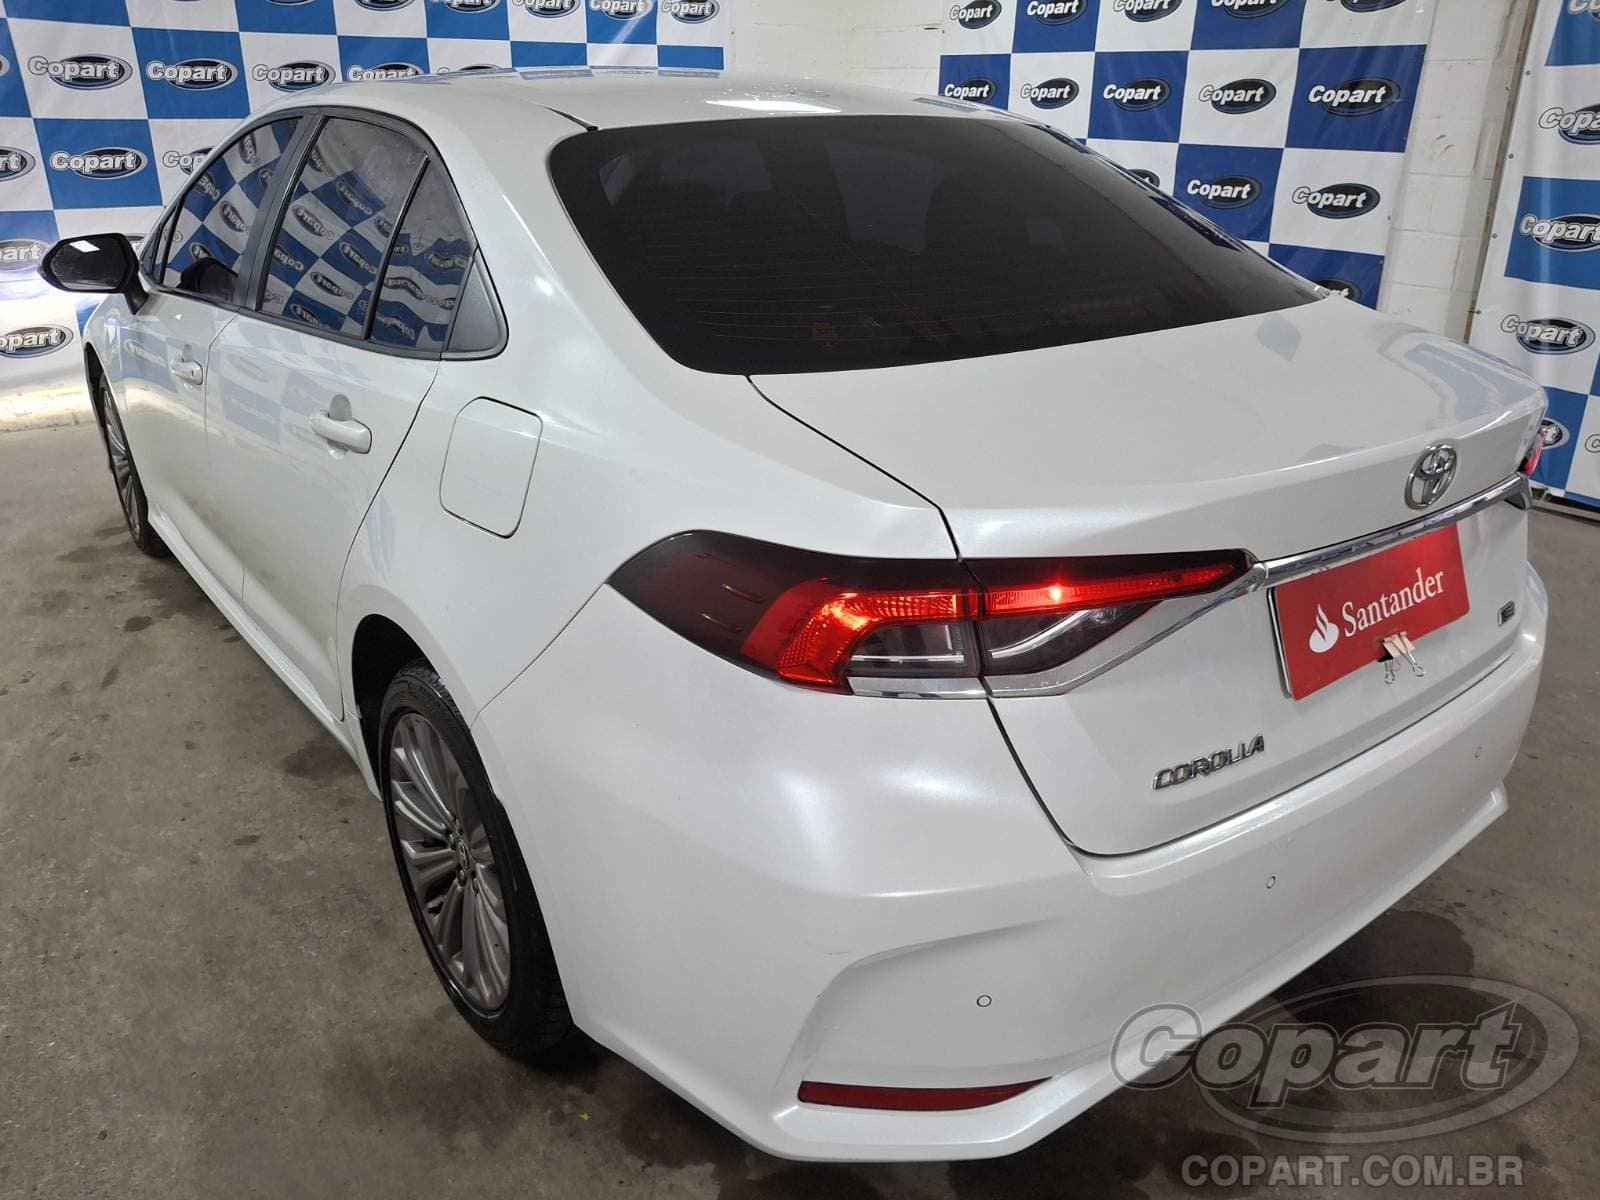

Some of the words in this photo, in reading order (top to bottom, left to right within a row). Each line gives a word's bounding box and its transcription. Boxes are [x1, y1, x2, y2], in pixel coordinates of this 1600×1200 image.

[661, 0, 712, 15] Copart
[950, 4, 993, 22] Copart
[1026, 0, 1080, 18] Copart
[27, 55, 120, 82] Copart
[145, 60, 228, 85] Copart
[252, 63, 327, 86] Copart
[944, 83, 990, 100] Copart
[1020, 83, 1071, 101] Copart
[1103, 84, 1162, 103] Copart
[1199, 85, 1265, 105] Copart
[1308, 84, 1388, 107] Copart
[1538, 106, 1600, 136] Copa
[50, 150, 138, 175] Copart
[162, 150, 208, 172] Cop
[1187, 179, 1252, 200] Copart
[1292, 186, 1367, 208] Copart
[1501, 314, 1583, 347] Copart
[1342, 566, 1444, 638] Santander
[1152, 733, 1265, 790] COROLLA
